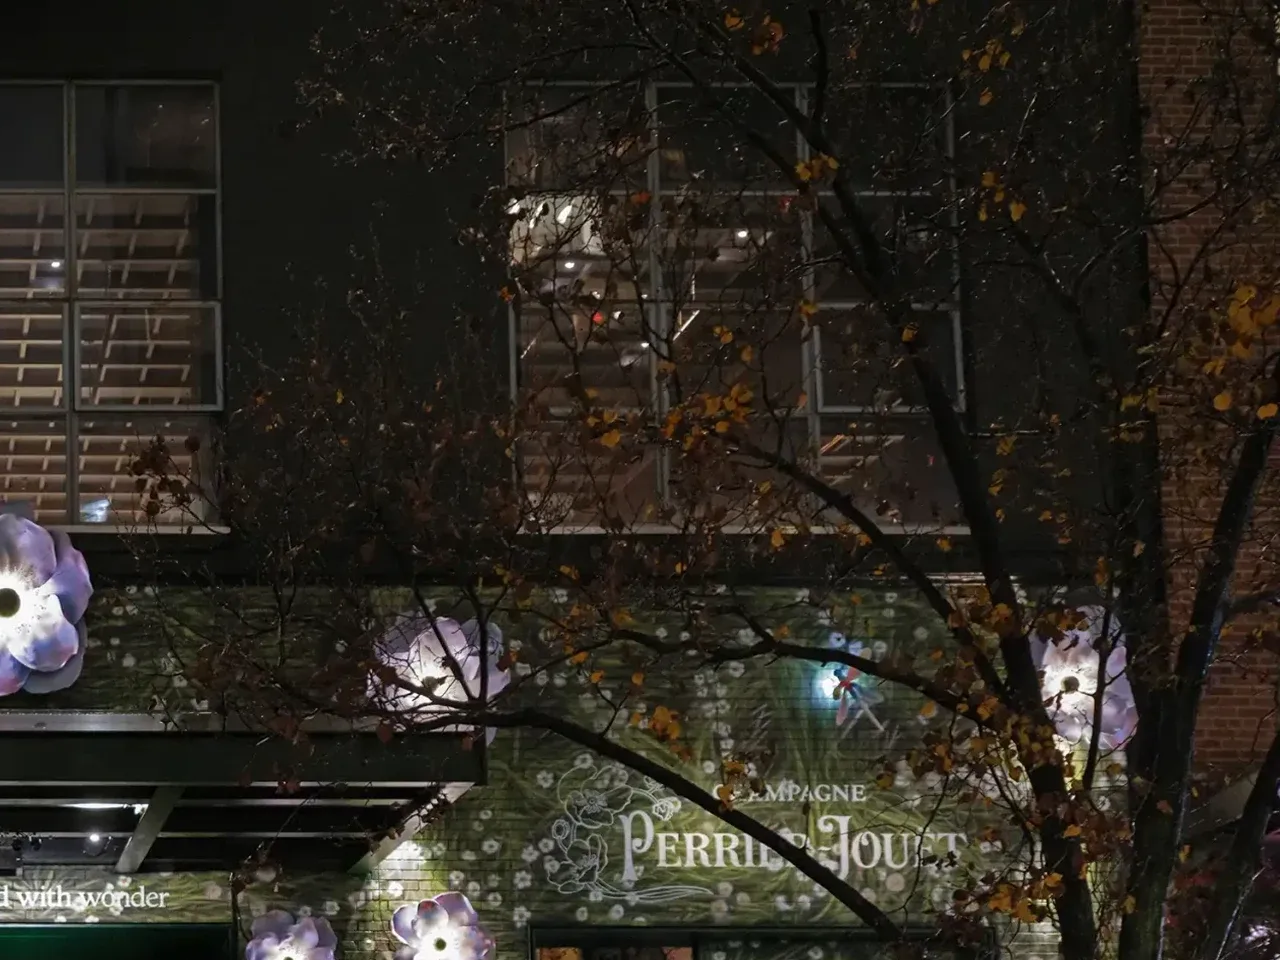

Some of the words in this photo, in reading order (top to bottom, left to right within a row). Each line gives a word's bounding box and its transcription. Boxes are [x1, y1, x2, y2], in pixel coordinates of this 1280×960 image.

[712, 783, 866, 802] CMPAGNE
[17, 885, 72, 907] with
[81, 887, 170, 908] wonder
